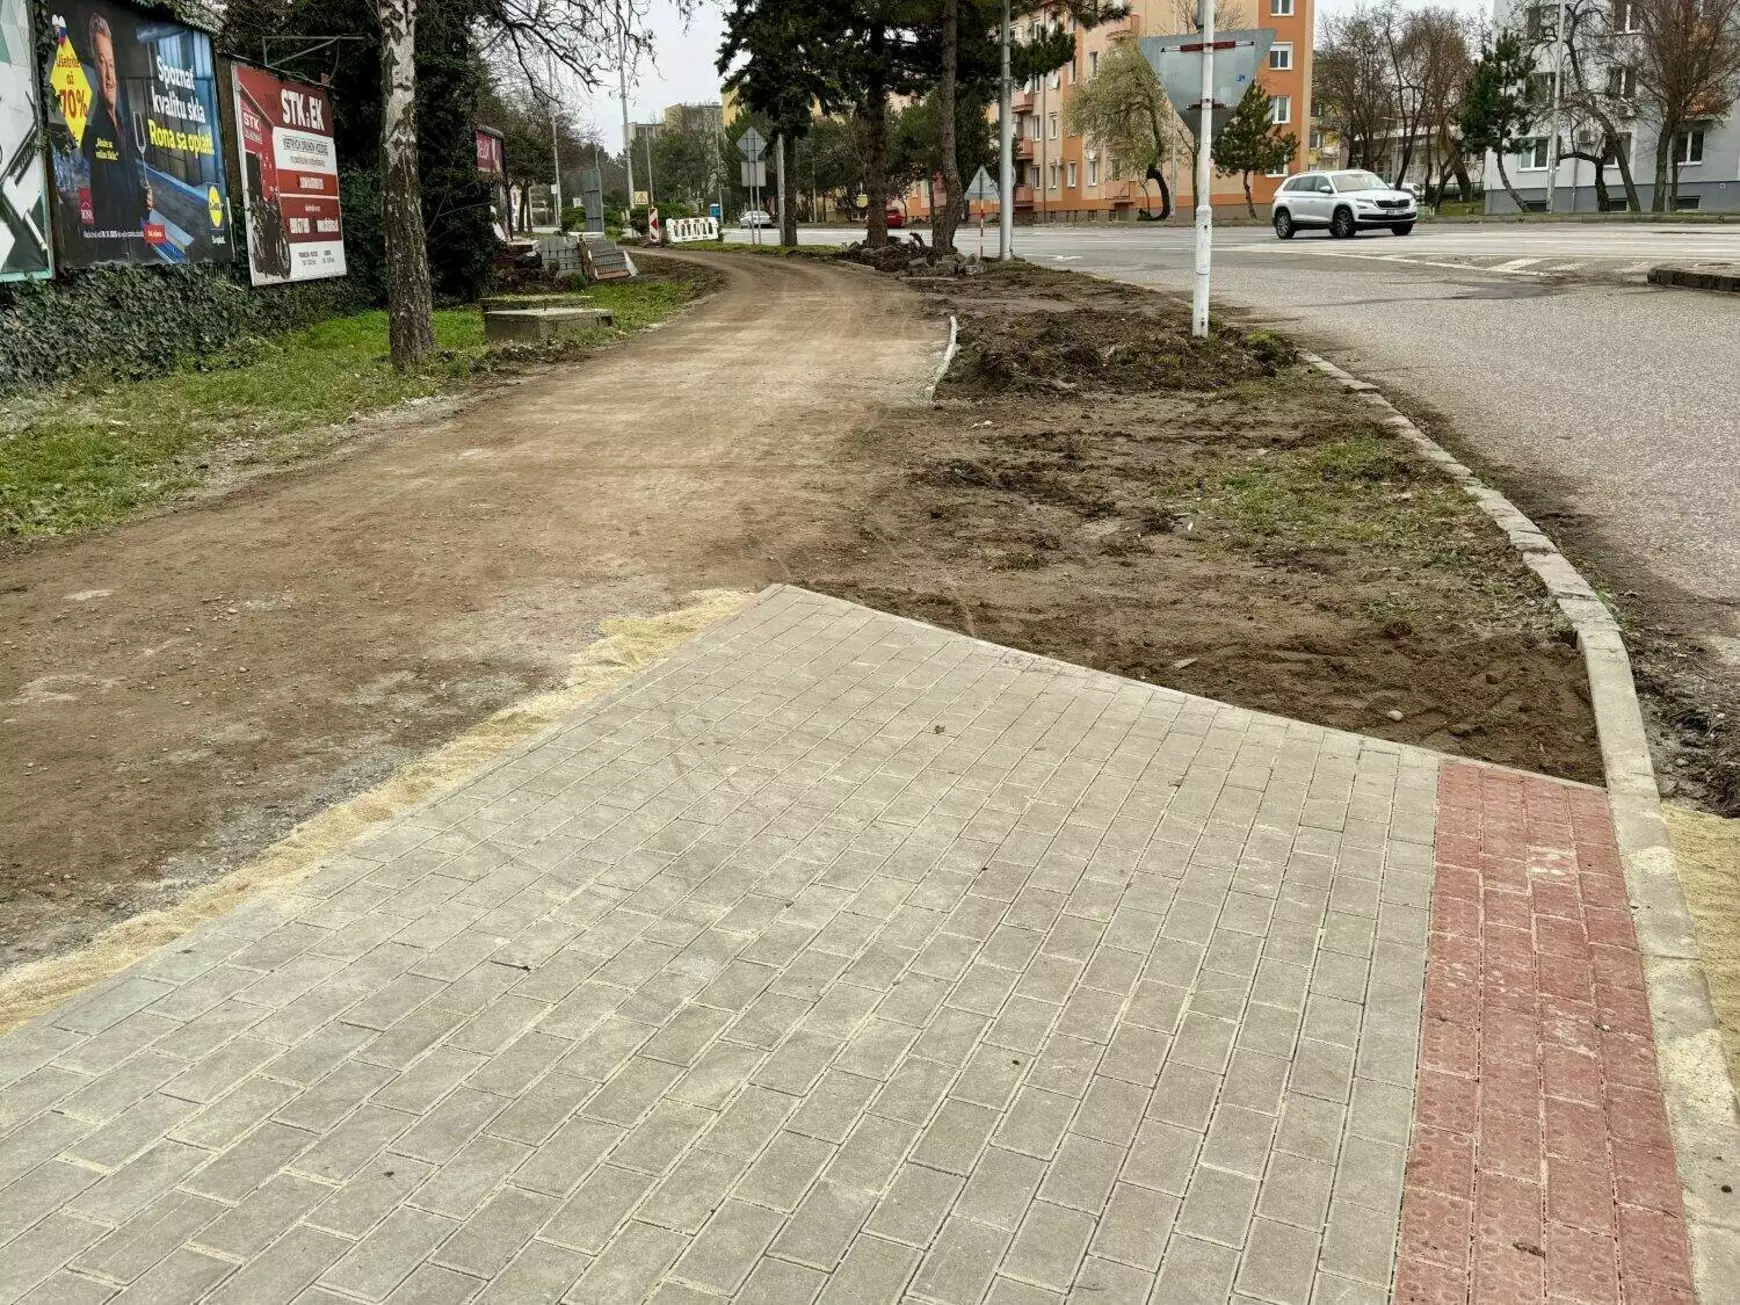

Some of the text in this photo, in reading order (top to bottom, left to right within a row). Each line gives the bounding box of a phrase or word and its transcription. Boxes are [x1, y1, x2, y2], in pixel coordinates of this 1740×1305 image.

[58, 88, 89, 118] 70%
[150, 86, 206, 123] kvalitu skla
[281, 88, 307, 127] STK
[308, 95, 325, 132] EK
[147, 118, 176, 149] Rona
[176, 131, 188, 152] sa
[243, 111, 260, 132] STK
